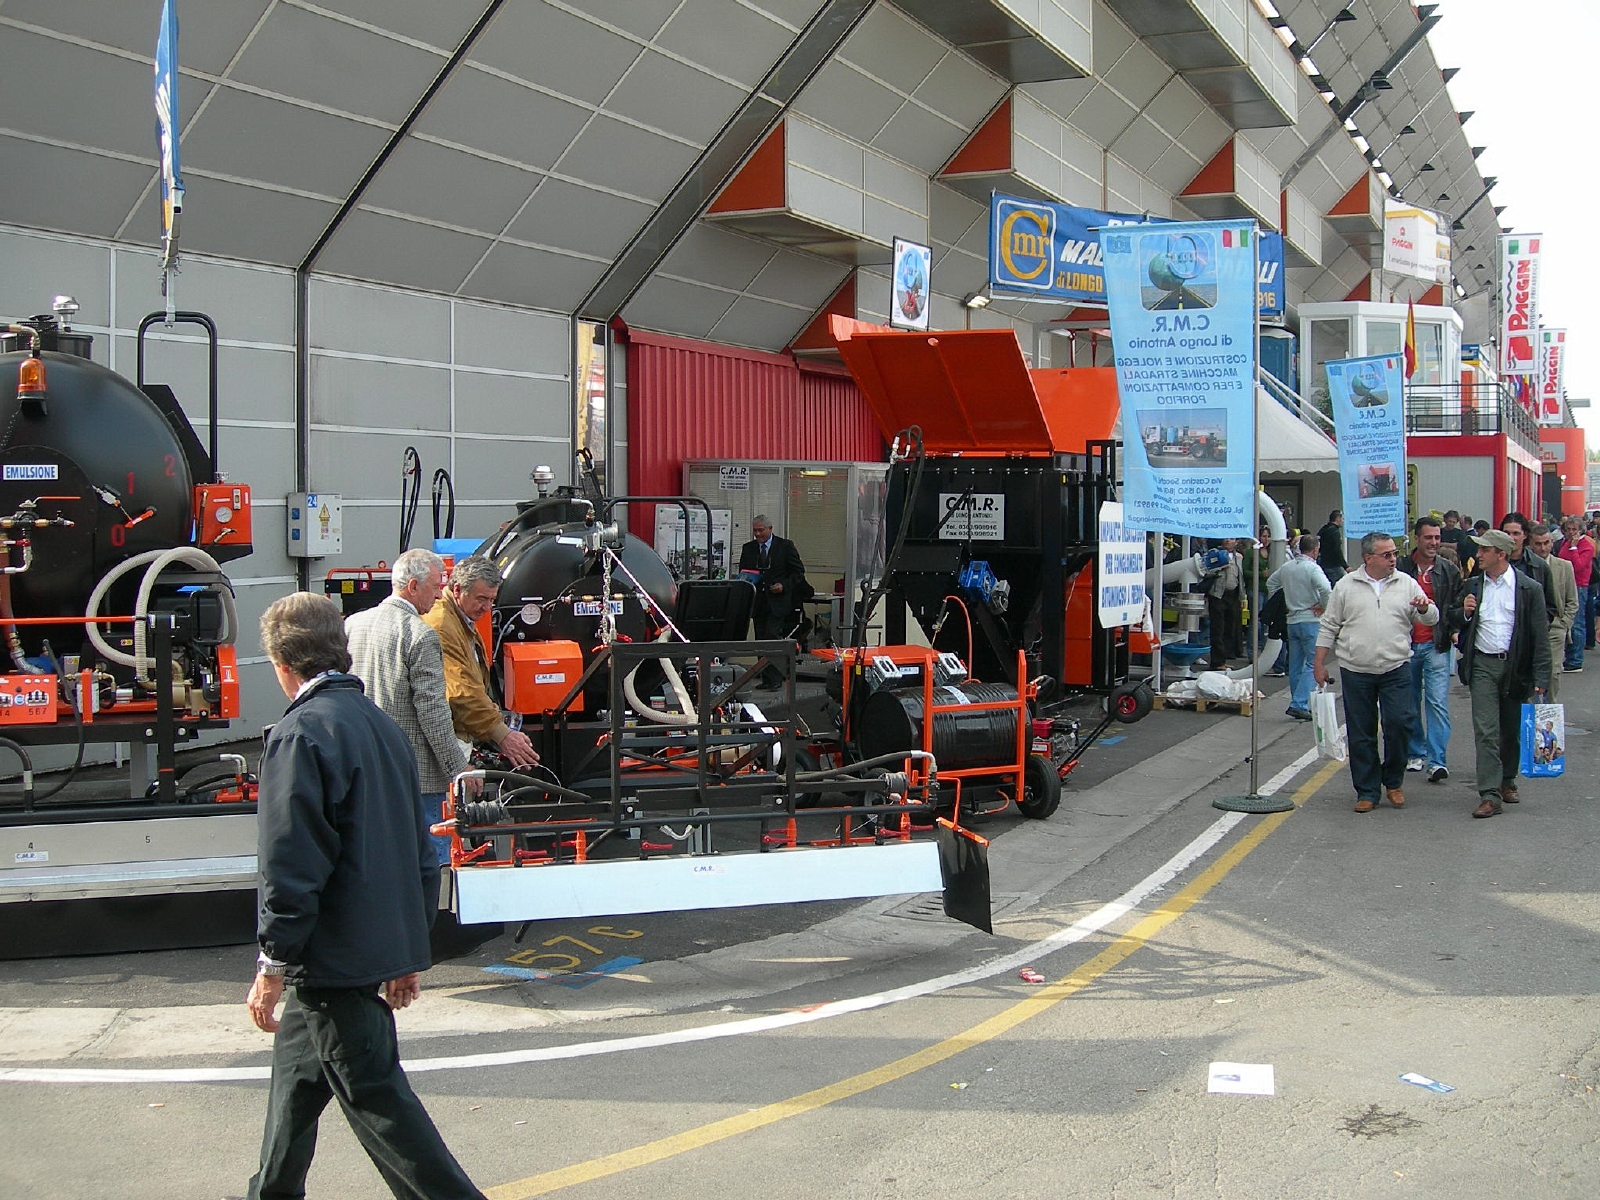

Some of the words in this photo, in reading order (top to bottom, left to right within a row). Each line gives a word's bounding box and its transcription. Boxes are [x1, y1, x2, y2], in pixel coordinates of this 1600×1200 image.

[1056, 270, 1066, 288] di
[1066, 272, 1103, 292] LONGO
[1508, 260, 1530, 331] PAGGIN
[1544, 346, 1558, 394] PAGGIN
[6, 466, 56, 478] EMULSIONE
[164, 454, 176, 476] 2
[721, 467, 748, 475] C.M.R.
[126, 472, 134, 494] 1
[308, 496, 316, 506] 24
[946, 497, 998, 510] C.M.R.
[110, 524, 125, 546] 0
[146, 836, 150, 844] 5
